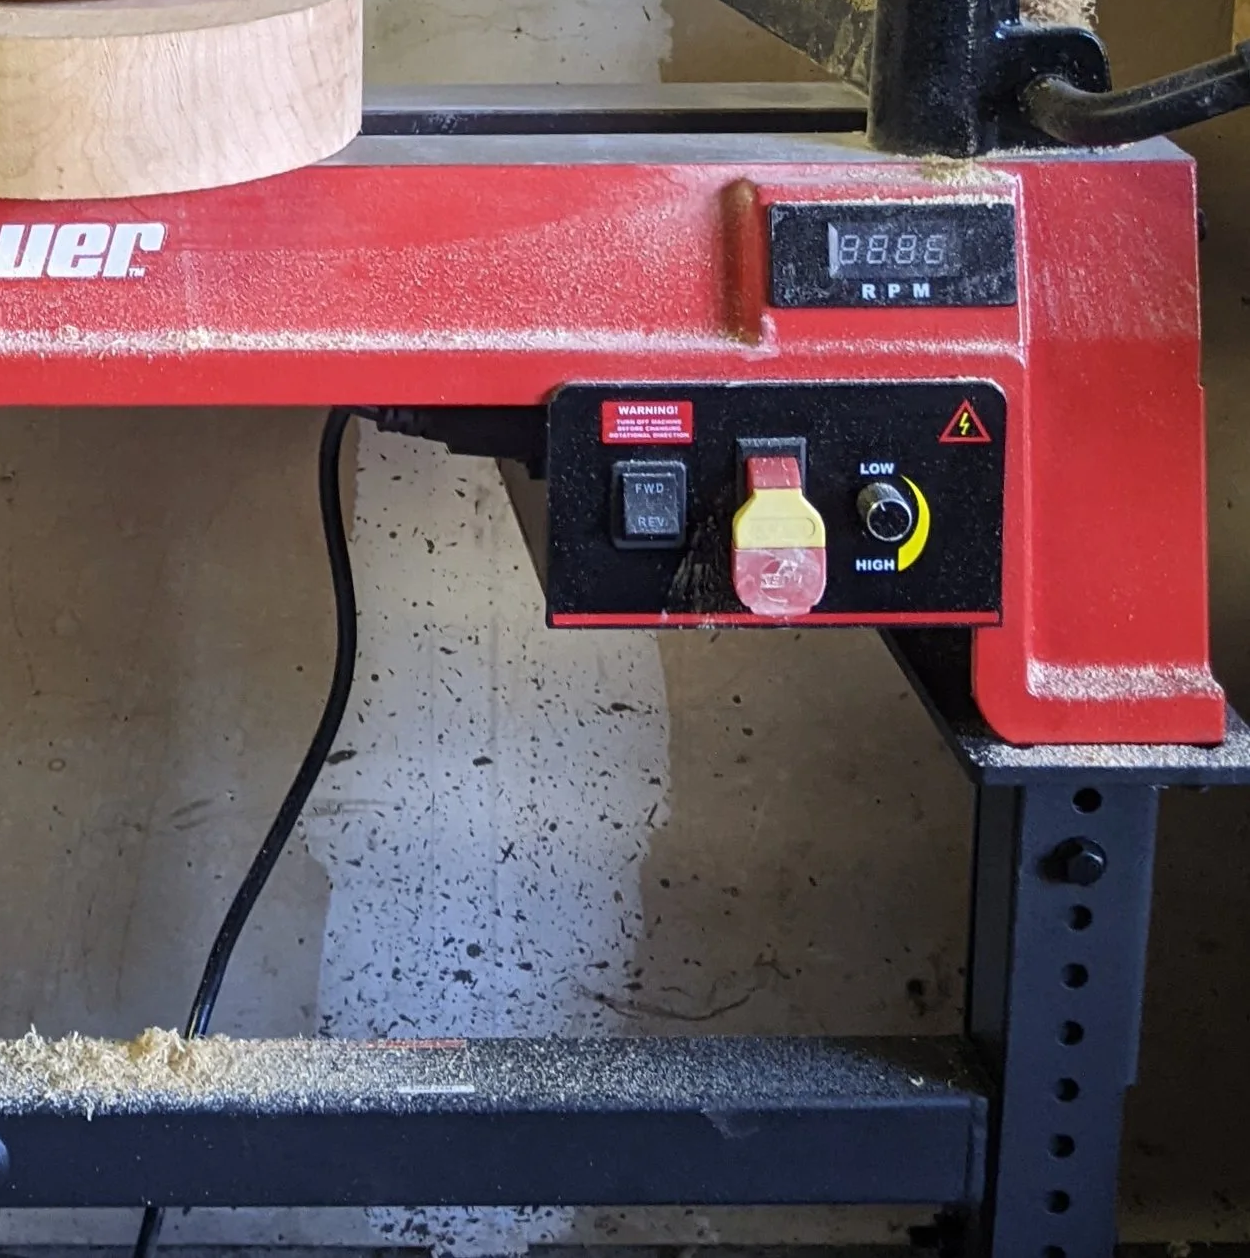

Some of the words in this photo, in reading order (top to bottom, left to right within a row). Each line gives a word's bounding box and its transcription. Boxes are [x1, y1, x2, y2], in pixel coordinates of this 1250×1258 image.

[618, 406, 678, 415] WARNING!
[860, 463, 895, 475] LOW
[635, 483, 664, 494] FWD
[638, 516, 665, 528] REV
[855, 559, 895, 571] HIGH
